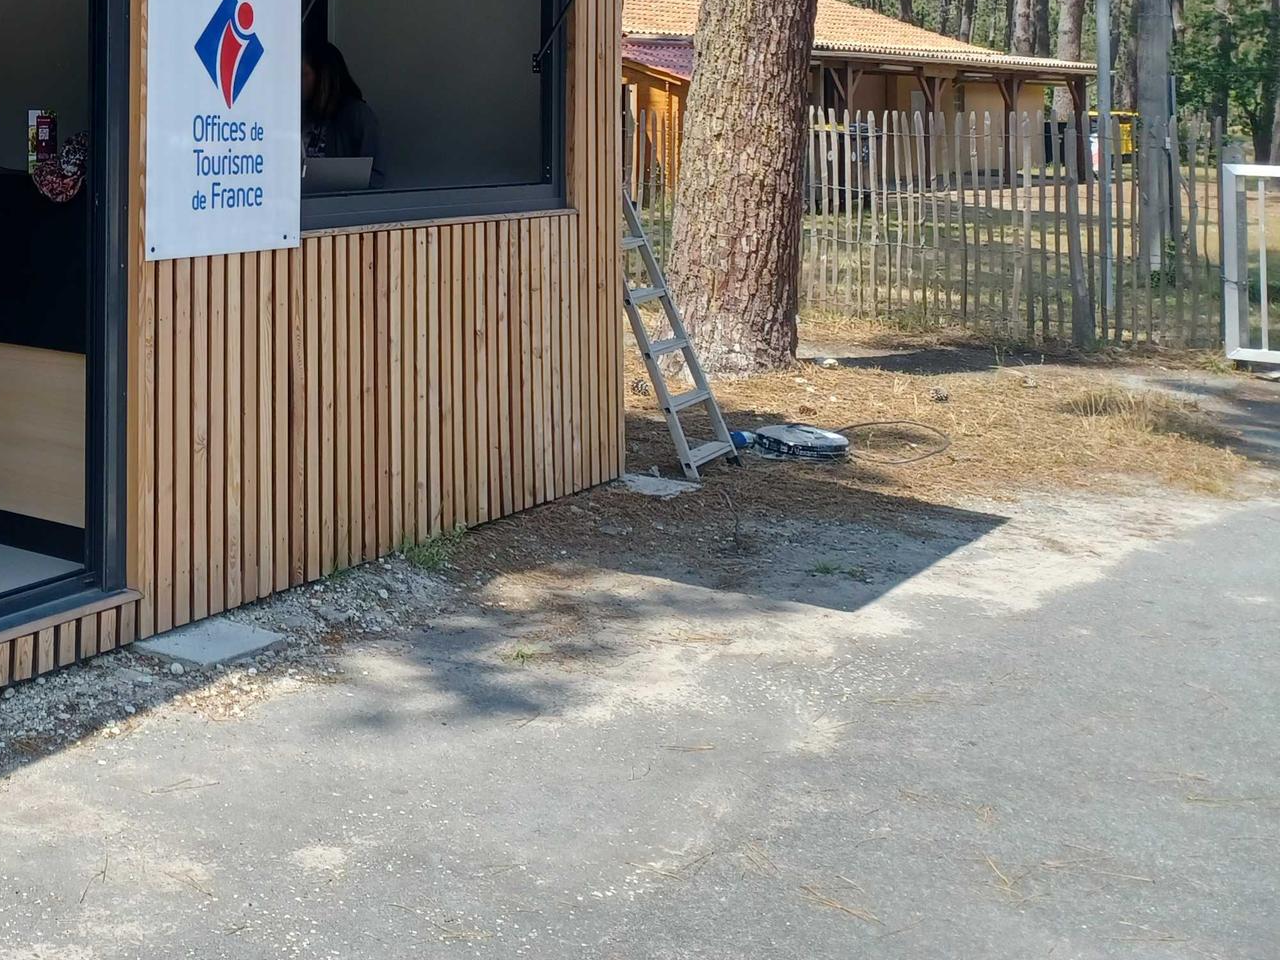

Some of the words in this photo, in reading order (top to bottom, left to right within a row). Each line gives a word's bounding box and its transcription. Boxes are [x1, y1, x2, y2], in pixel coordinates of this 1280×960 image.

[193, 114, 246, 142] Offices
[250, 121, 264, 142] de
[193, 148, 264, 176] Tourisme
[192, 190, 207, 211] de
[211, 182, 264, 210] France
